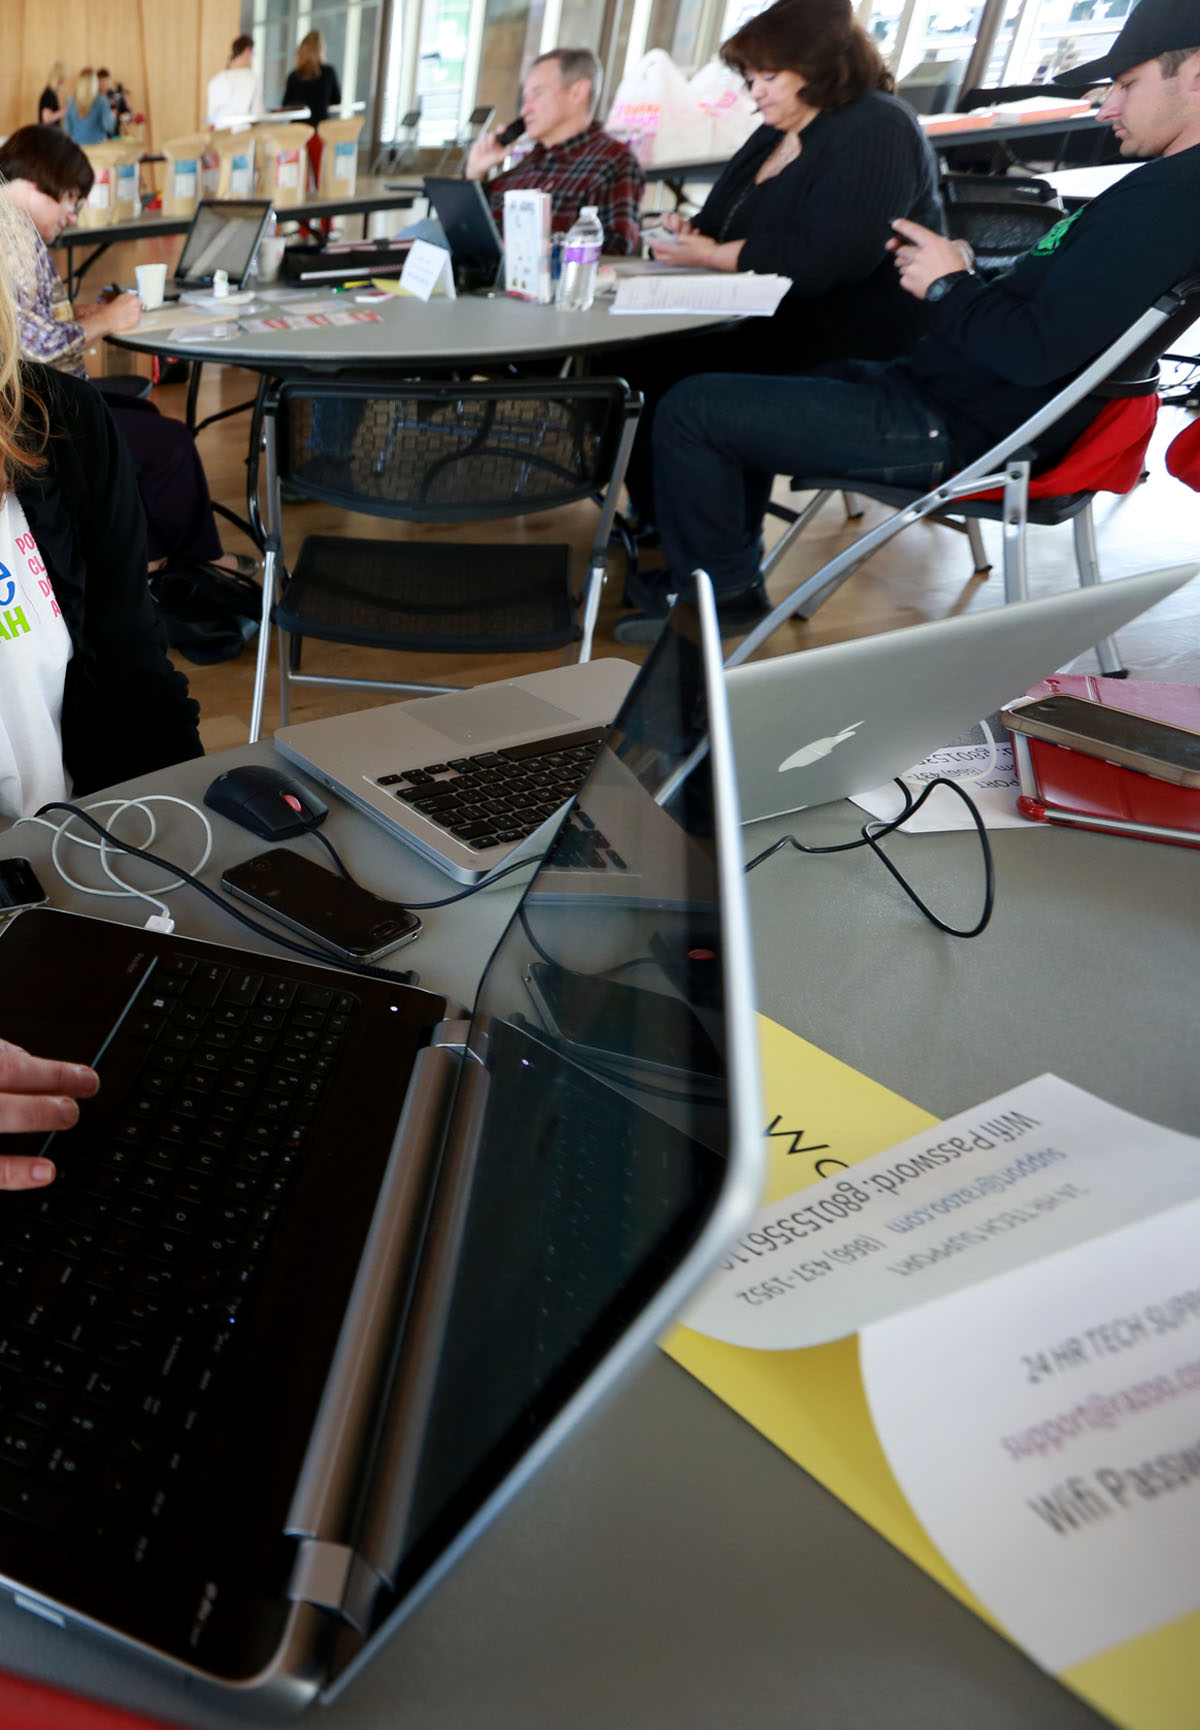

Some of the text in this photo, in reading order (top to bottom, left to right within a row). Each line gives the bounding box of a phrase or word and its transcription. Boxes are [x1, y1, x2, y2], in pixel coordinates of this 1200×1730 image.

[861, 1130, 996, 1196] Password:
[734, 1148, 1067, 1306] support@razoo.com (866) 437-1952
[1020, 1351, 1053, 1384] 24
[1049, 1336, 1088, 1372] HR
[1084, 1313, 1149, 1358] TECH
[1025, 1475, 1113, 1535] Wifi
